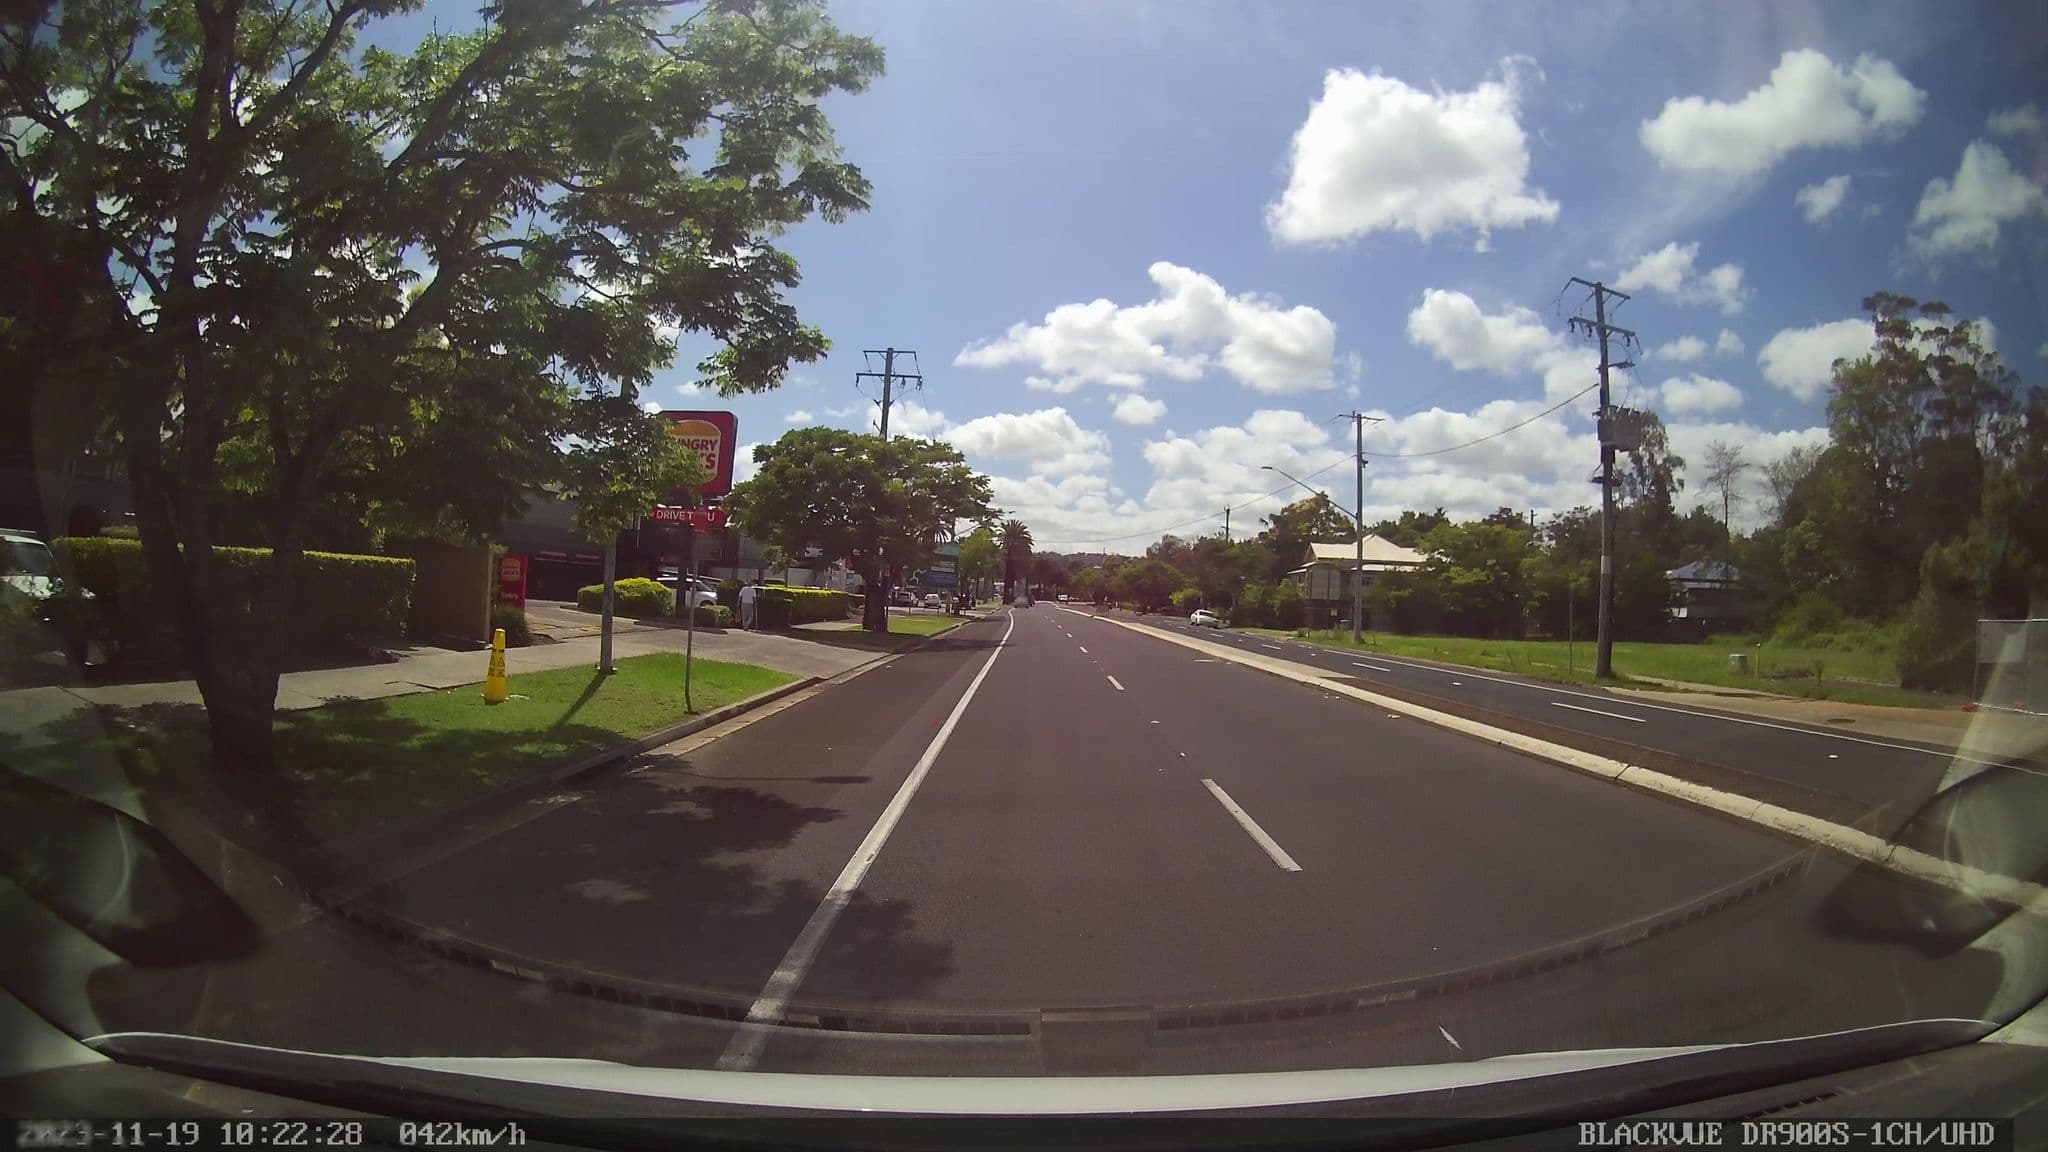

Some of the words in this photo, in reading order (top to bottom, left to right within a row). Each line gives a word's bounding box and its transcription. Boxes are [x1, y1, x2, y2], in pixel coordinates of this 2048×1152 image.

[677, 439, 718, 451] NGRY
[656, 510, 685, 520] DRIVE
[687, 510, 715, 522] TU
